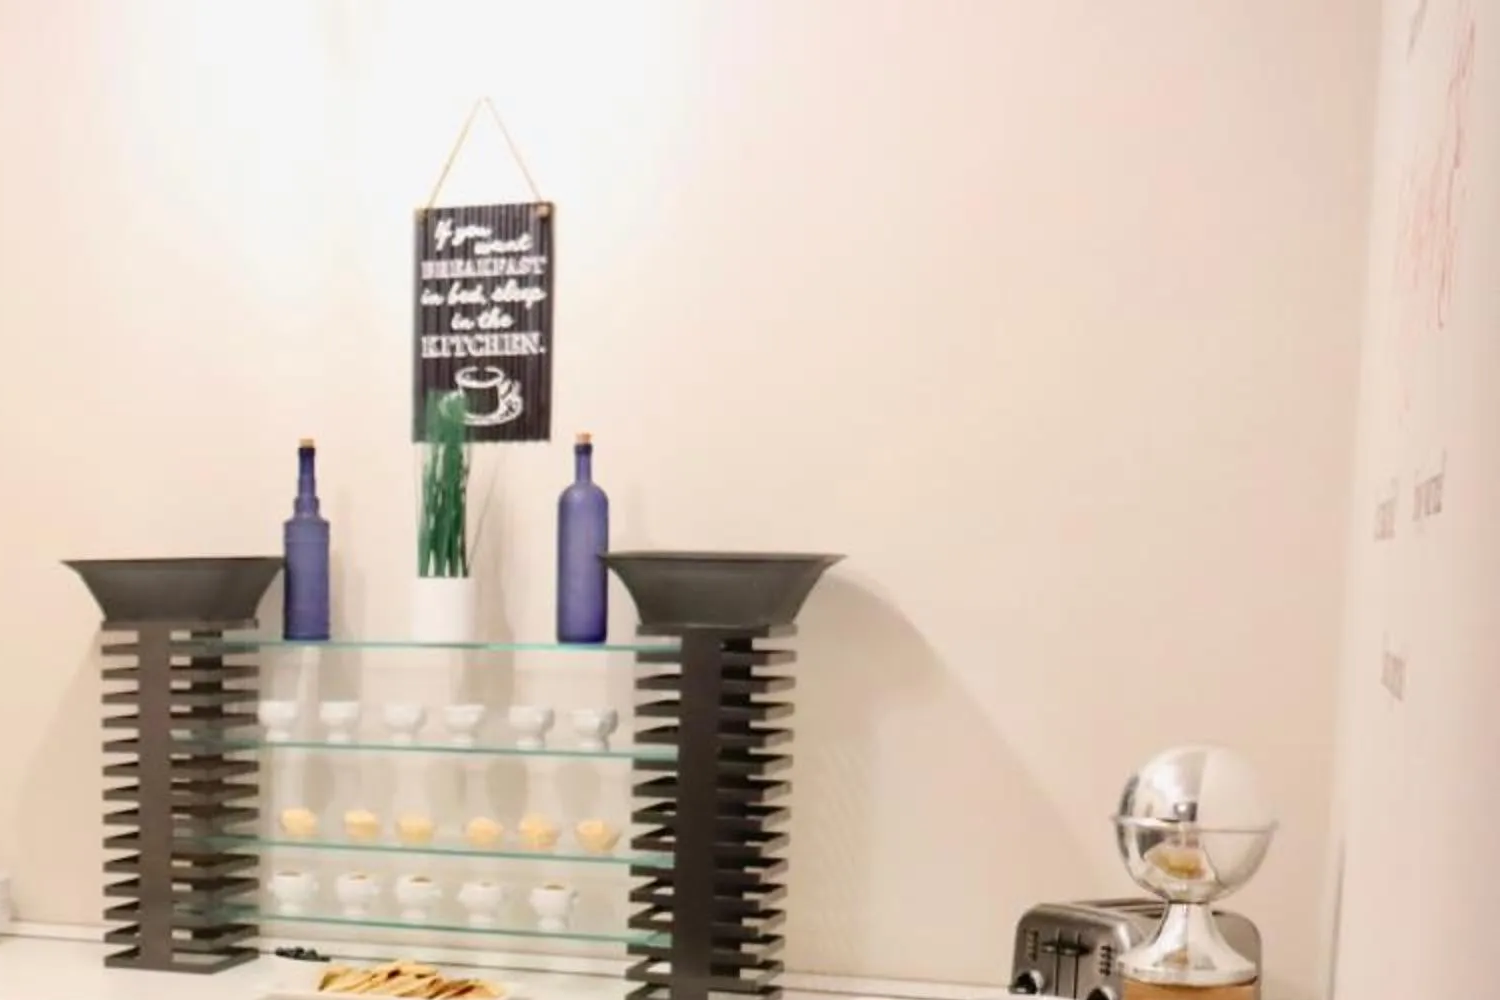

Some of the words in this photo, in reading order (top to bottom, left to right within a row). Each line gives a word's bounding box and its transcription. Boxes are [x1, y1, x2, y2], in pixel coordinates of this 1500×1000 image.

[433, 217, 453, 251] If
[451, 224, 492, 247] you
[474, 233, 534, 255] want
[420, 256, 548, 280] BREAKFAST
[420, 287, 445, 306] in
[491, 279, 547, 311] sleep
[451, 312, 475, 331] in
[477, 306, 514, 330] the
